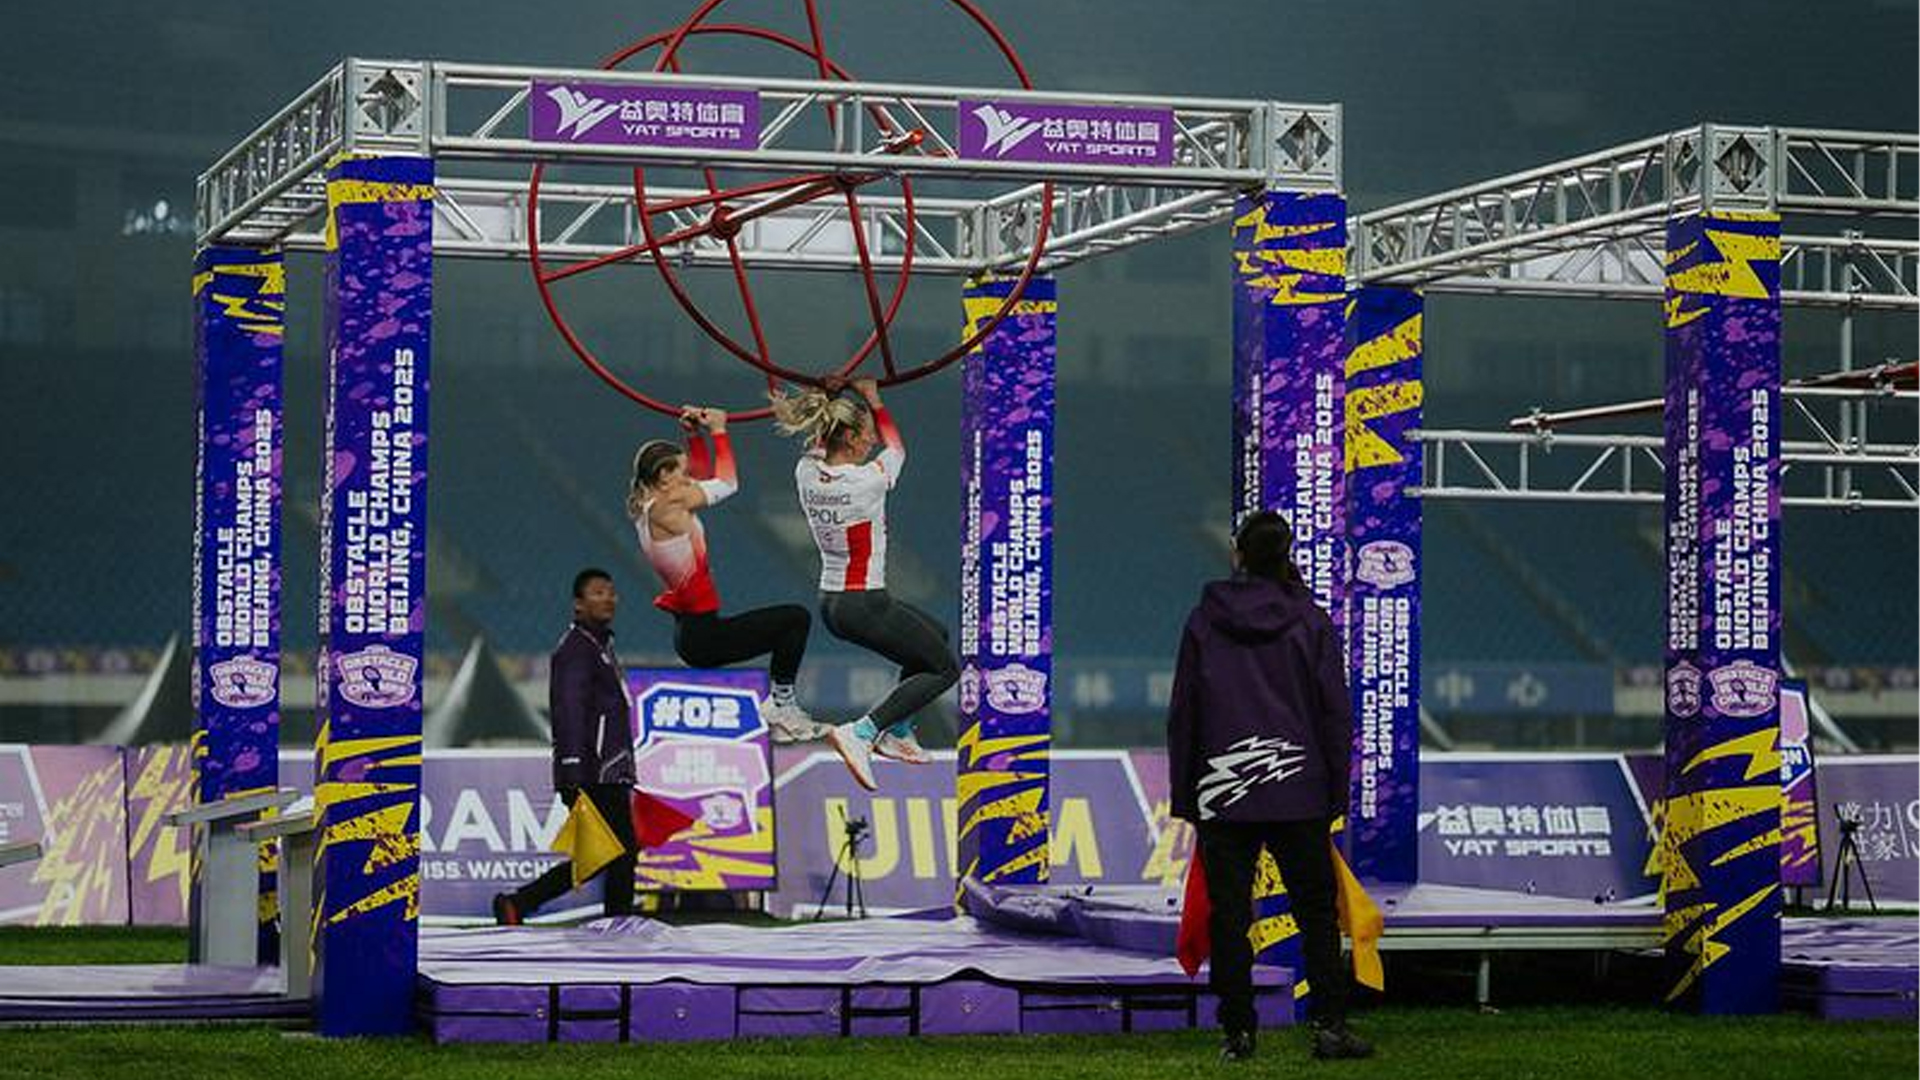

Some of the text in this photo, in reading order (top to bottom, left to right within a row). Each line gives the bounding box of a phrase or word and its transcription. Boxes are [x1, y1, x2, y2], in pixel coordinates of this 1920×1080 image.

[619, 100, 744, 124] 益奥特体育
[622, 124, 741, 140] YAT SPORTS
[1045, 142, 1157, 157] YAT SPORTS
[235, 461, 254, 647] WORLD CHAMPS
[253, 409, 272, 647] BEIJING, CHINA 2025
[367, 411, 392, 634] WORLD CHAMPS
[389, 348, 415, 635] BEIJING, CHINA 2025
[808, 508, 847, 525] POL
[1024, 429, 1043, 657] BEIJING, CHINA 2025
[1297, 433, 1314, 541] CHAMPS
[1315, 373, 1335, 615] IJING, CHINA 2025
[1733, 446, 1751, 650] WORLD CHAMPS
[1752, 388, 1771, 650] BEIJING, CHINA 2025
[217, 527, 234, 647] OBSTACLE
[345, 491, 367, 634] OBSTACLE
[991, 542, 1008, 656] OBSTACLE
[1007, 479, 1025, 656] WORLD CHAMPS
[1715, 519, 1732, 650] OBSTACLE
[652, 695, 740, 729] #02
[1361, 597, 1378, 819] BEIJING, CHINA 2025
[1378, 597, 1394, 770] WORLD CHAMPS
[1394, 597, 1410, 708] OBSTACLE
[1444, 839, 1612, 857] YAT SPORTS
